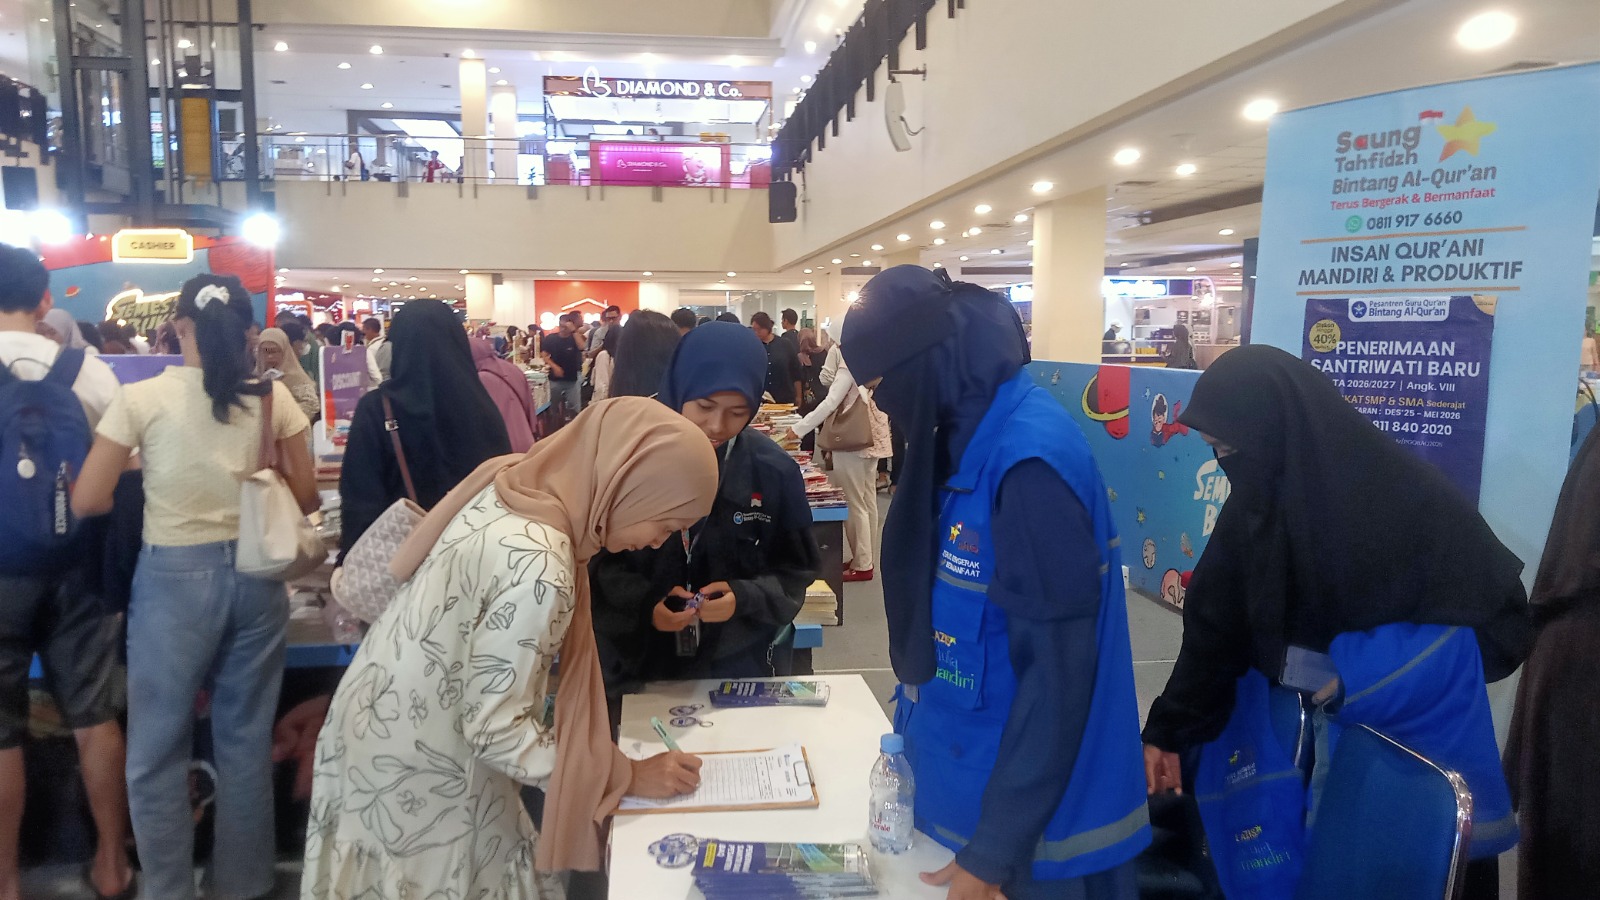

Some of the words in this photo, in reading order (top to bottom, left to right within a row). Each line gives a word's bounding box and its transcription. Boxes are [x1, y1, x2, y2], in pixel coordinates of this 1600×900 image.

[616, 80, 700, 97] DIAMOND
[704, 82, 715, 97] &
[718, 82, 743, 98] Co.
[1336, 125, 1422, 153] Saung
[1334, 150, 1418, 173] Tahfidzh
[1332, 174, 1398, 195] Bintang
[1401, 165, 1497, 189] Al-Qur'an
[1330, 199, 1359, 211] Terus
[1362, 195, 1409, 210] Bergerak
[1411, 193, 1421, 204] &
[1424, 187, 1496, 203] Bermanfaat
[1366, 216, 1392, 230] 0811
[1395, 213, 1420, 228] 917
[1424, 210, 1463, 226] 6660
[130, 242, 176, 250] CASHIER
[1331, 244, 1390, 263] INSAN
[1395, 238, 1484, 260] QUR'ANI
[1298, 266, 1378, 286] MANDIRI
[1383, 266, 1395, 283] &
[1401, 261, 1523, 283] PRODUKTIF
[1368, 307, 1402, 318] Bintang
[1404, 306, 1446, 317] Al-Qur'an
[1369, 300, 1404, 308] Pesantren
[1404, 299, 1422, 307] Guru
[1423, 299, 1447, 307] Qur'an
[1313, 333, 1337, 345] 40%
[1335, 340, 1456, 357] PENERIMAAN
[1311, 358, 1422, 376] SANTRIWATI
[1427, 360, 1481, 377] BARU
[1332, 378, 1346, 388] TA
[1346, 379, 1396, 389] 2026/2027
[1406, 381, 1437, 392] Angk.
[1439, 382, 1456, 392] VIII
[1342, 394, 1365, 404] KAT
[1365, 395, 1386, 405] SMP
[1388, 396, 1396, 406] &
[1398, 397, 1424, 407] SMA
[1426, 400, 1466, 410] Sederajat
[1423, 410, 1439, 419] MEI
[1440, 411, 1461, 420] 2026
[1372, 420, 1389, 431] 811
[1392, 421, 1419, 433] 840
[1421, 423, 1452, 436] 2020
